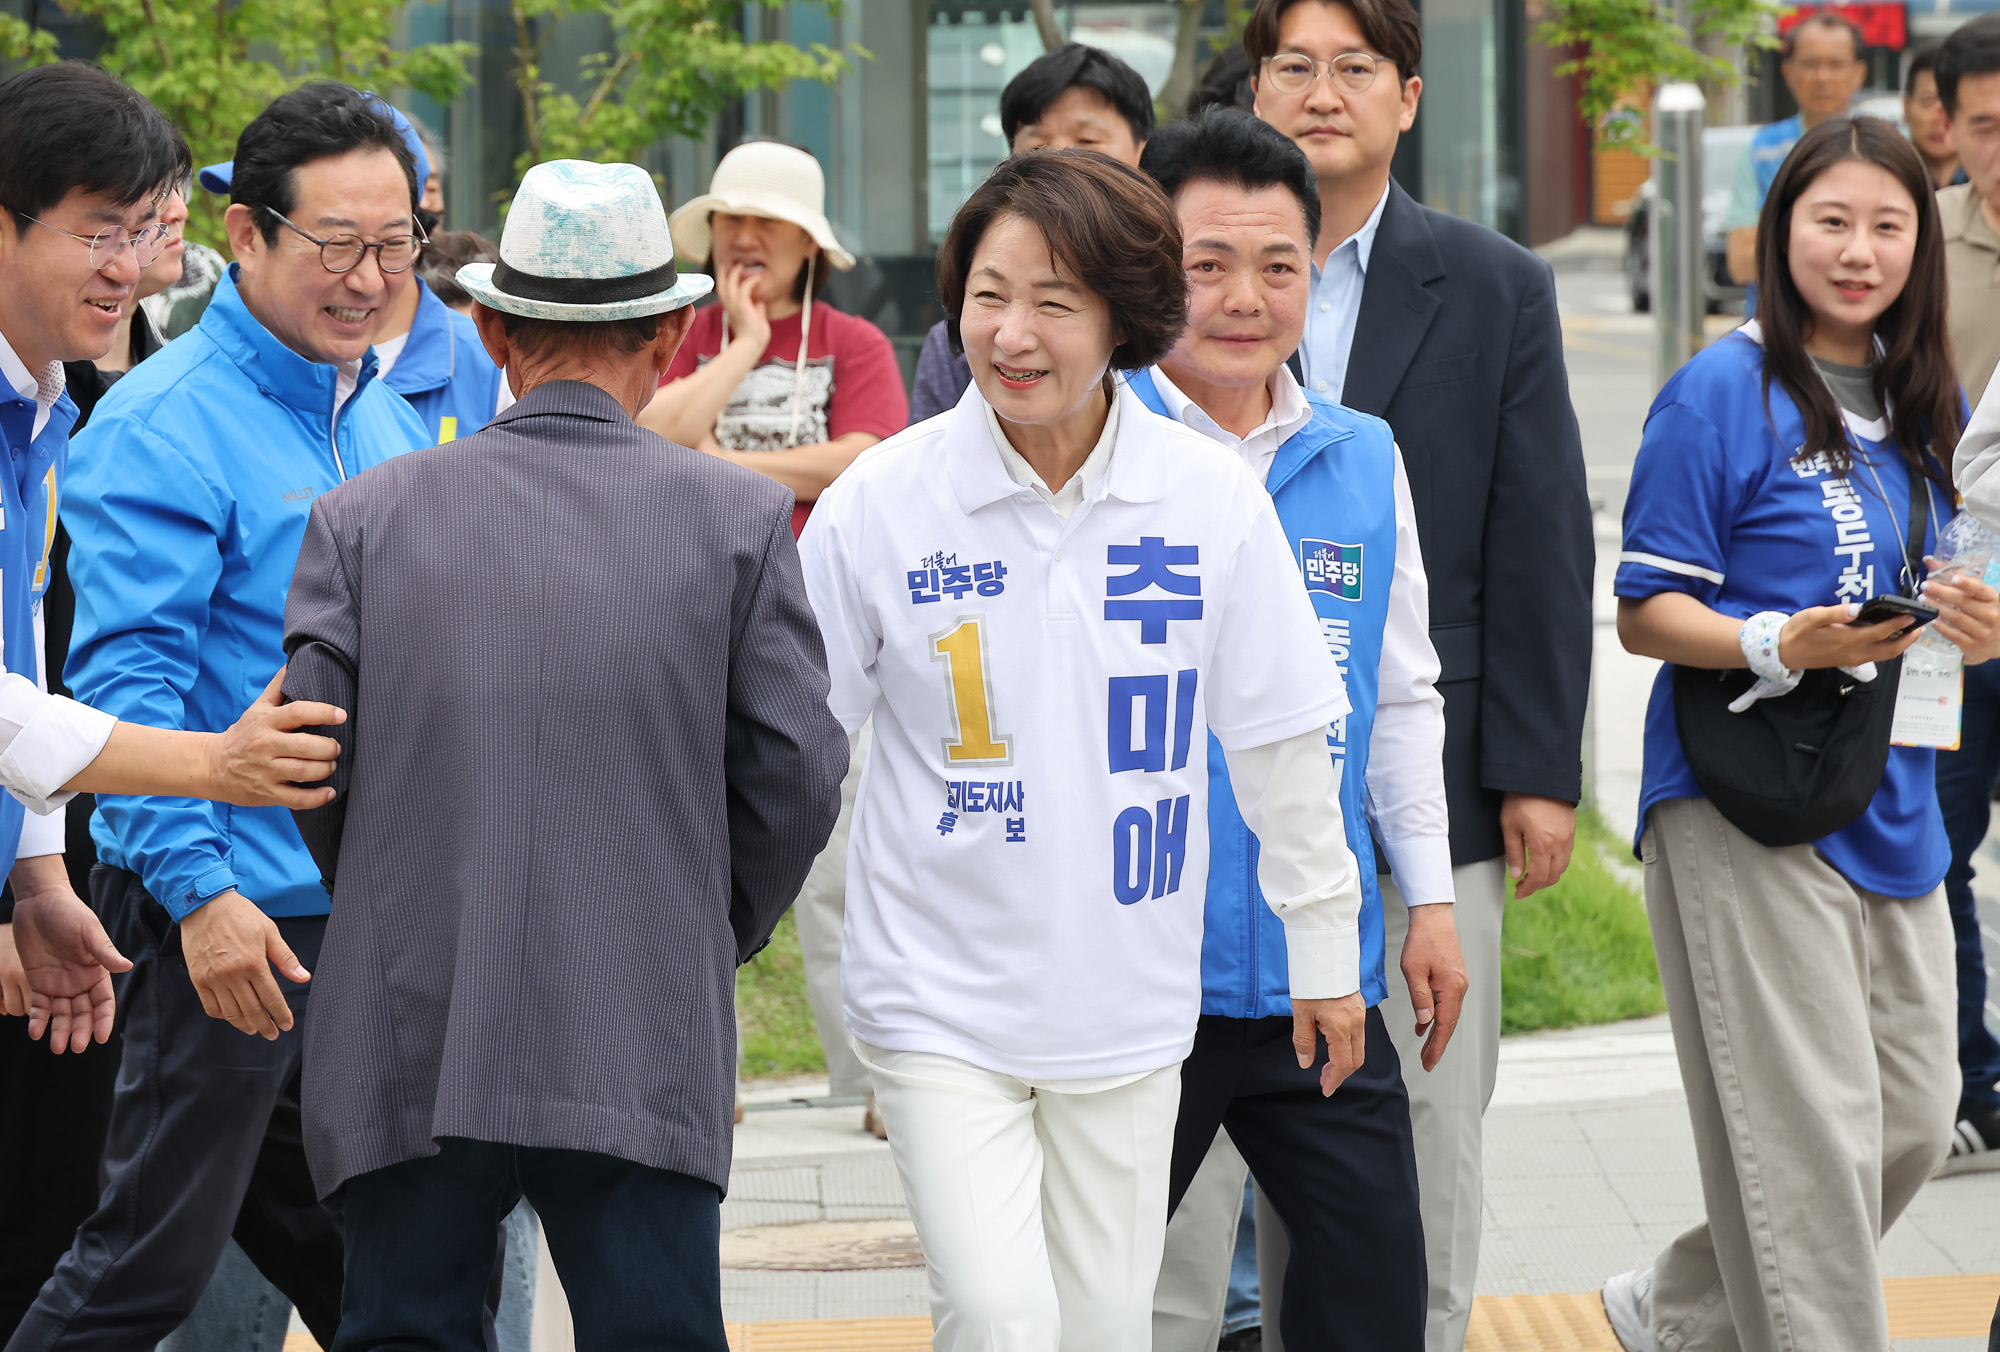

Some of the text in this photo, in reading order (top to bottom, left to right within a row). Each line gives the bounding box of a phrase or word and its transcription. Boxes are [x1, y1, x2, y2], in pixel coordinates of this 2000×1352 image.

[281, 486, 315, 504] MILLET
[1313, 547, 1335, 562] 더불어
[1820, 478, 1875, 605] 동두천
[920, 550, 957, 571] 더불어
[1306, 558, 1360, 587] 민주당
[907, 560, 1008, 605] 민주당
[928, 613, 1014, 768] 1
[1104, 536, 1204, 906] 추미애
